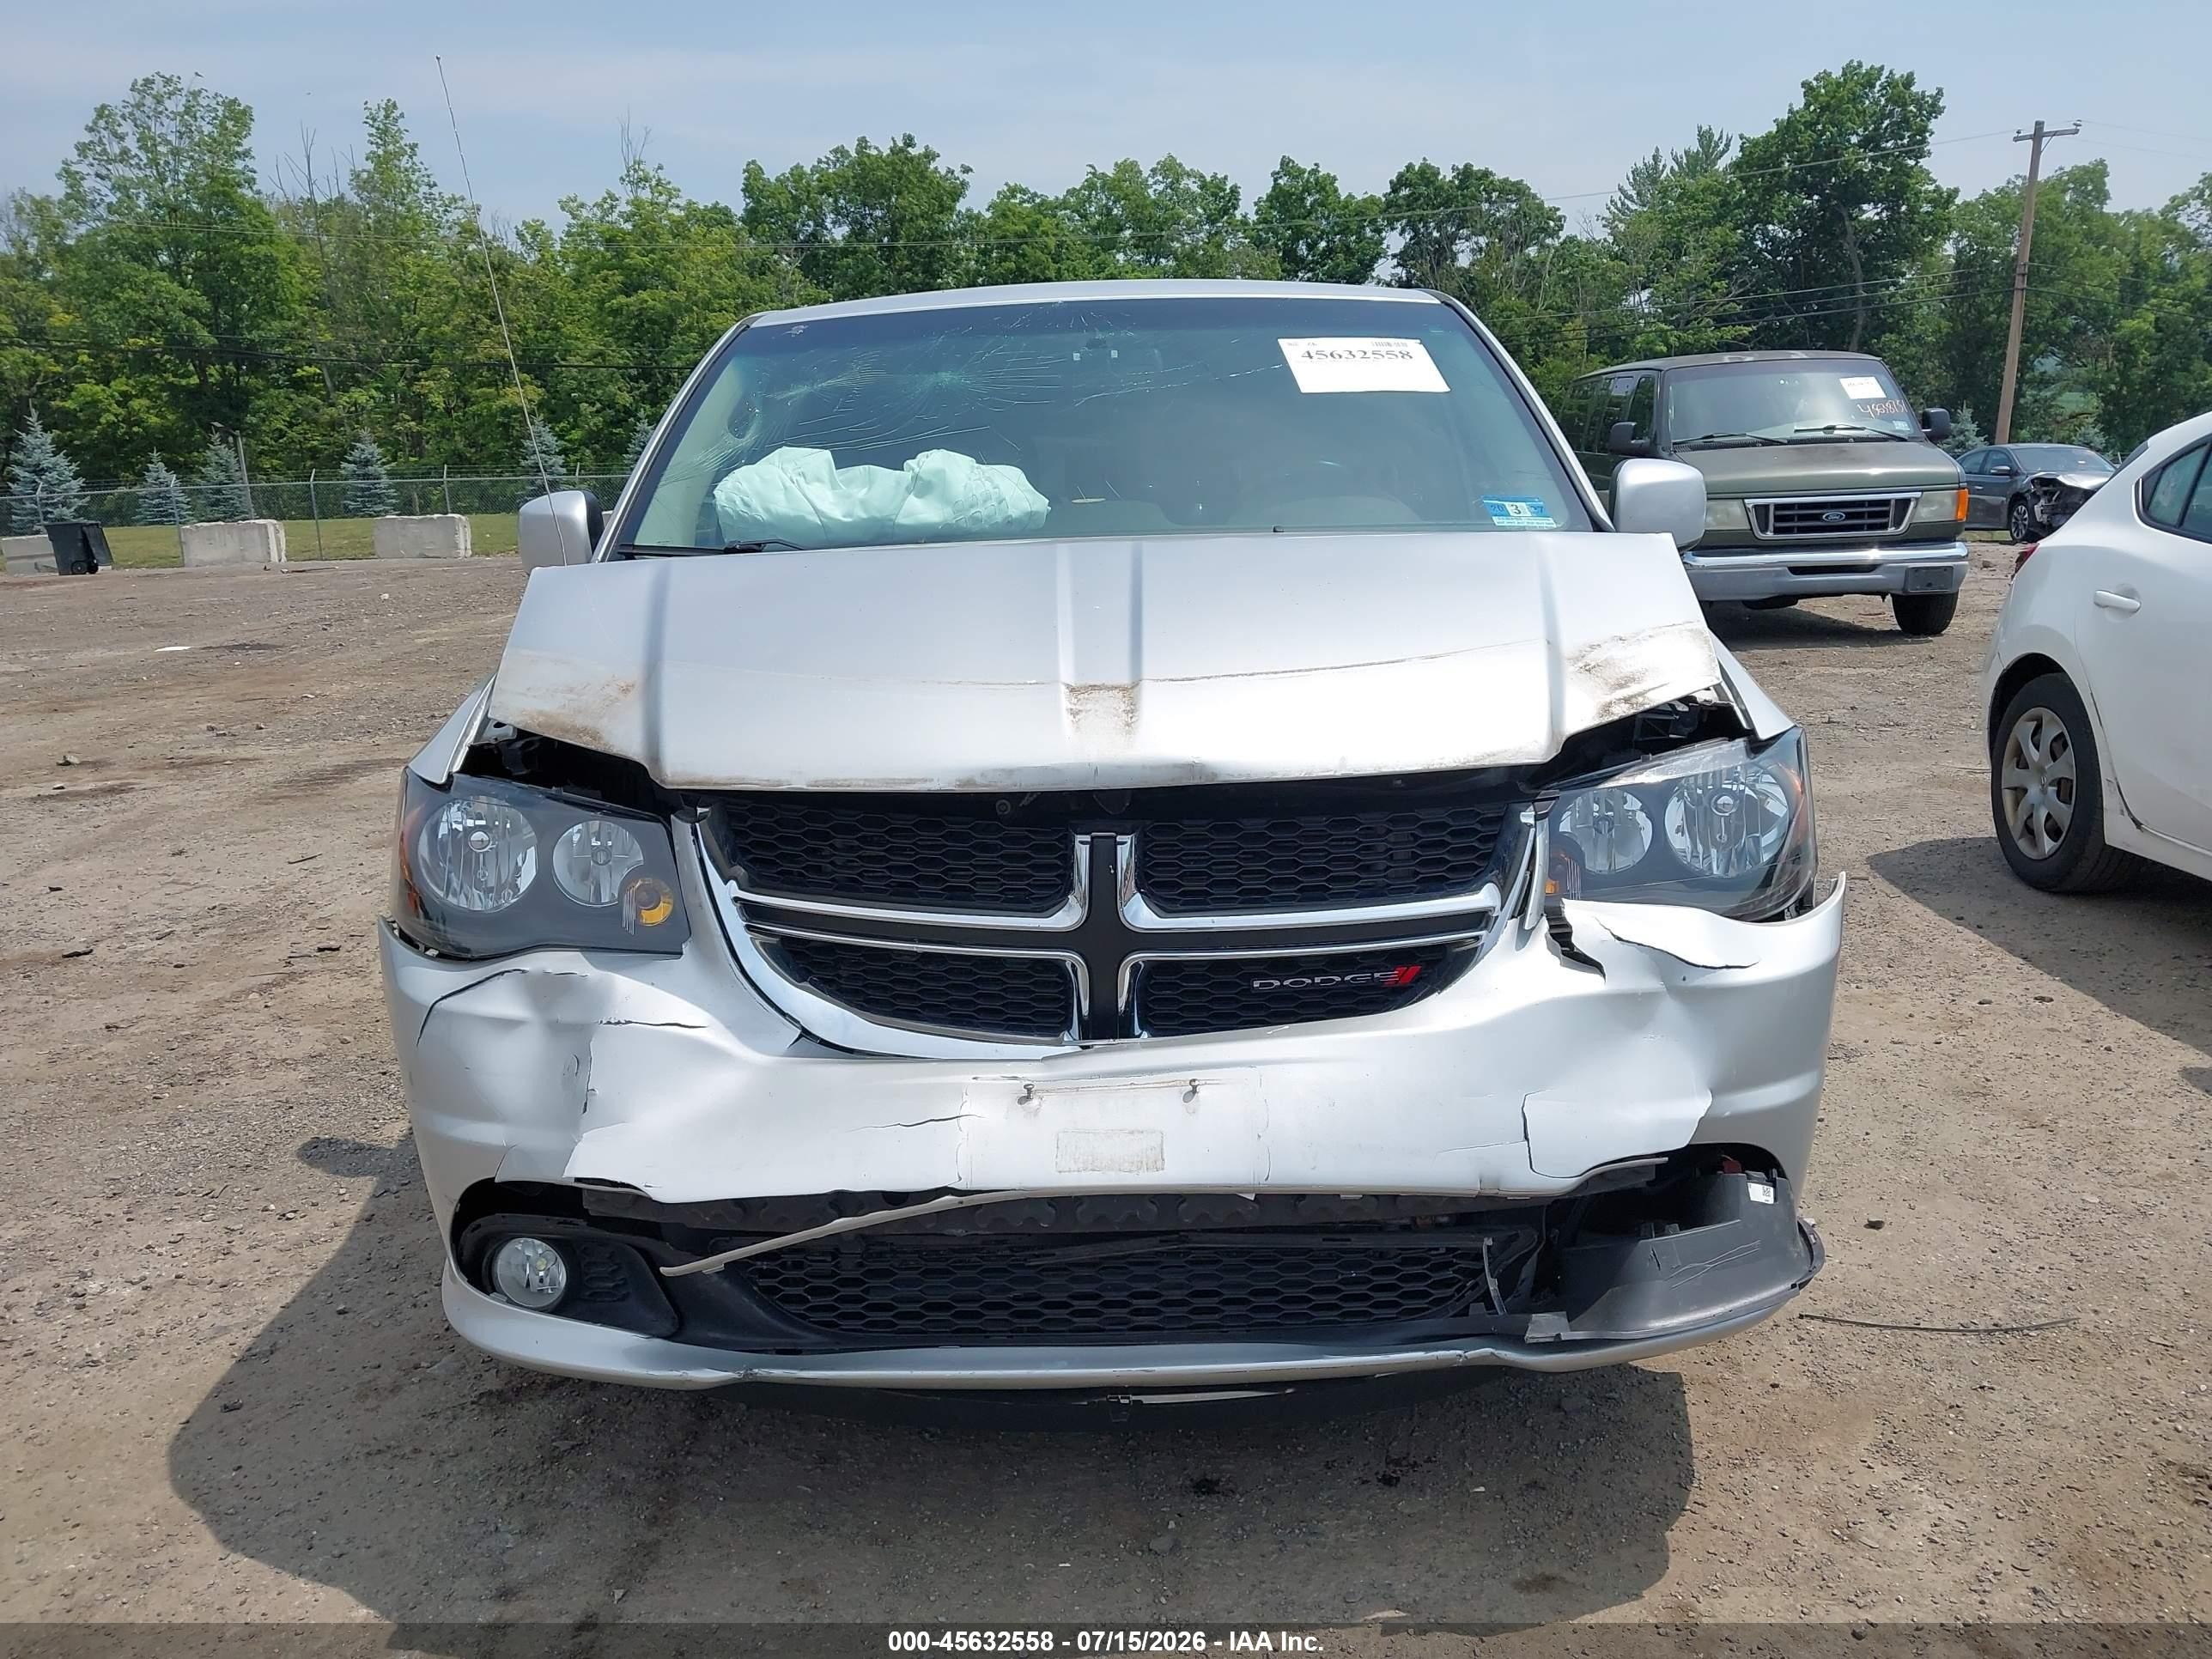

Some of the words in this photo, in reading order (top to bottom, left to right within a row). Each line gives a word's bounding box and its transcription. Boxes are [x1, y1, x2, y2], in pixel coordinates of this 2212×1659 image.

[1301, 349, 1413, 360] 45632558
[1510, 504, 1522, 515] 3
[1253, 970, 1400, 990] DODGE
